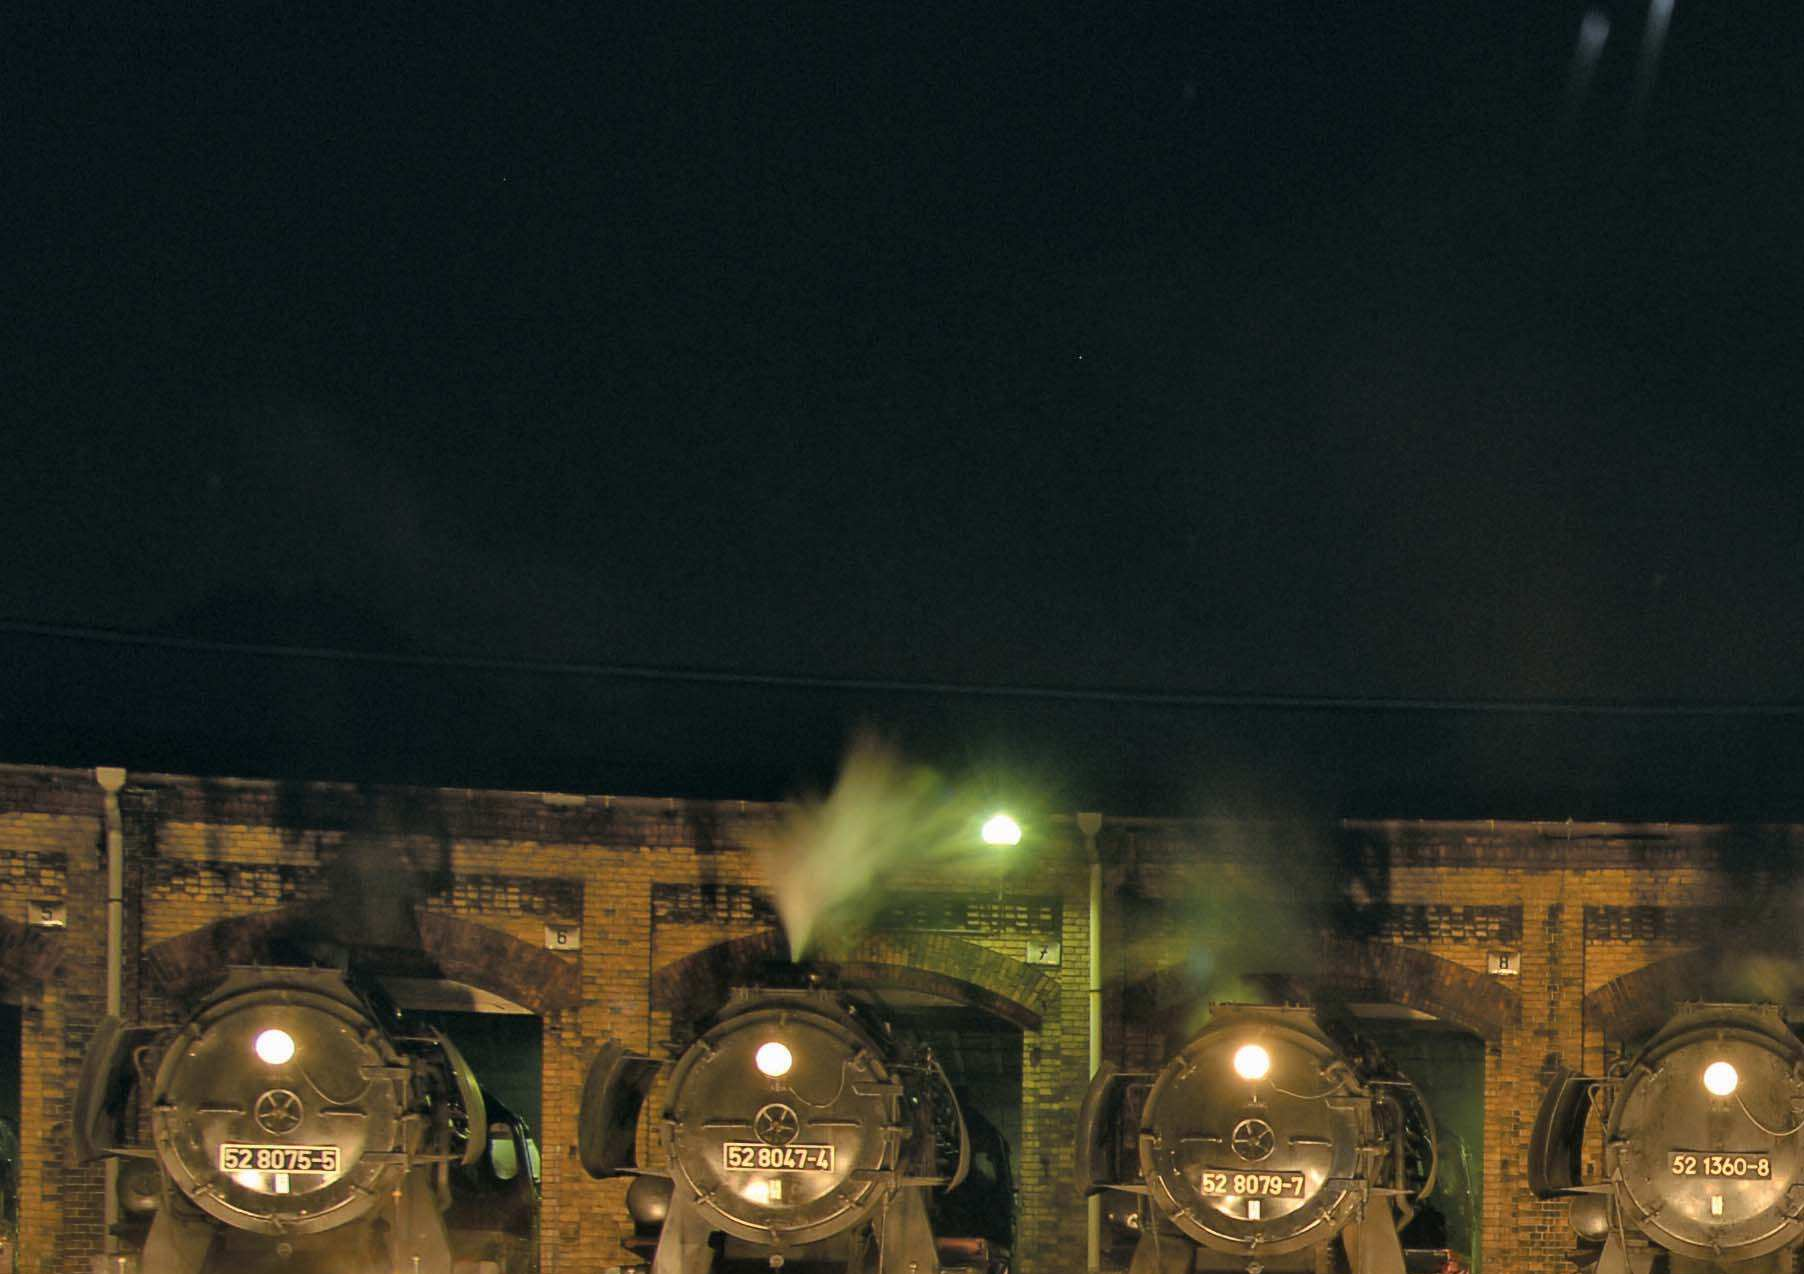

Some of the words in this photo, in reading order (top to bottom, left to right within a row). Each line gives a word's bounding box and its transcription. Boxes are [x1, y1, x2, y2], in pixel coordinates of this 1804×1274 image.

[557, 929, 567, 944] 6
[225, 1148, 253, 1169] 52
[256, 1149, 336, 1171] 8075-5
[728, 1147, 755, 1167] 52
[758, 1148, 829, 1169] 8047-4
[1672, 1155, 1697, 1175] 52
[1703, 1156, 1770, 1177] 1360-8
[1202, 1173, 1227, 1193] 52
[1233, 1174, 1304, 1196] 8079-7
